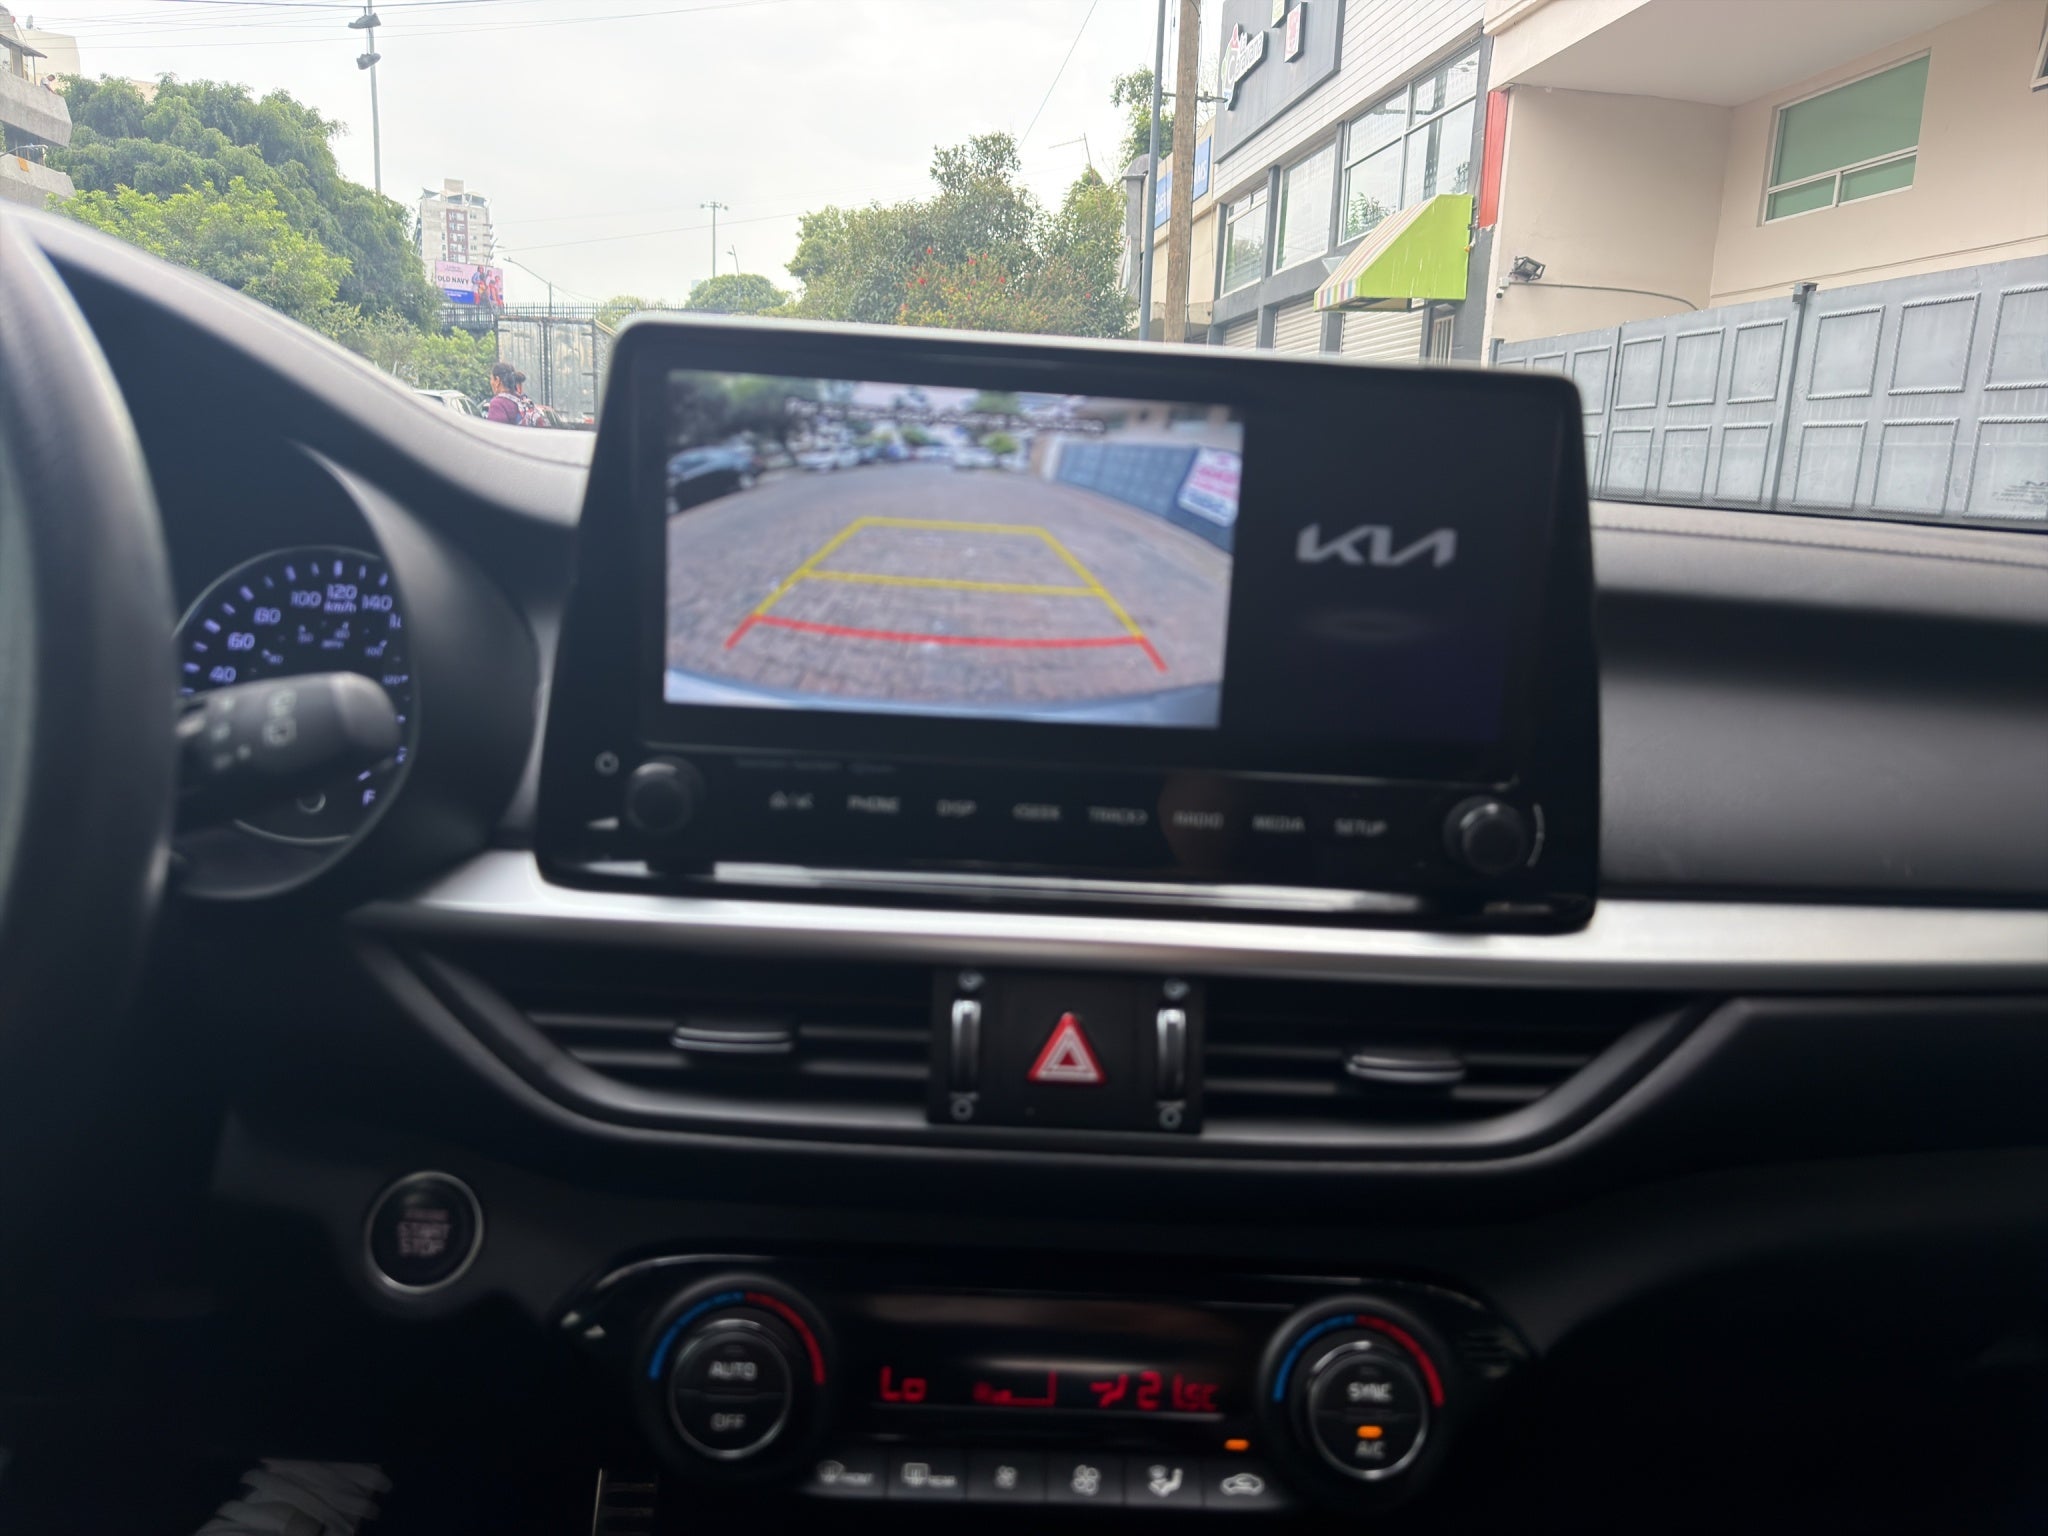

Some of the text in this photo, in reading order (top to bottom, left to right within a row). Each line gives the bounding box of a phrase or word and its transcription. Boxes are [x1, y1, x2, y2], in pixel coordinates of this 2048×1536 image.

[1296, 521, 1457, 568] KIA
[290, 590, 322, 608] 100
[326, 584, 357, 600] 120
[323, 601, 357, 614] km/h
[361, 594, 393, 612] 140
[253, 606, 281, 626] 80
[227, 632, 256, 651] 60
[208, 666, 237, 684] 40
[362, 789, 376, 805] F
[708, 1361, 758, 1381] AUTO
[1348, 1382, 1393, 1402] SYNC
[710, 1412, 747, 1431] OFF
